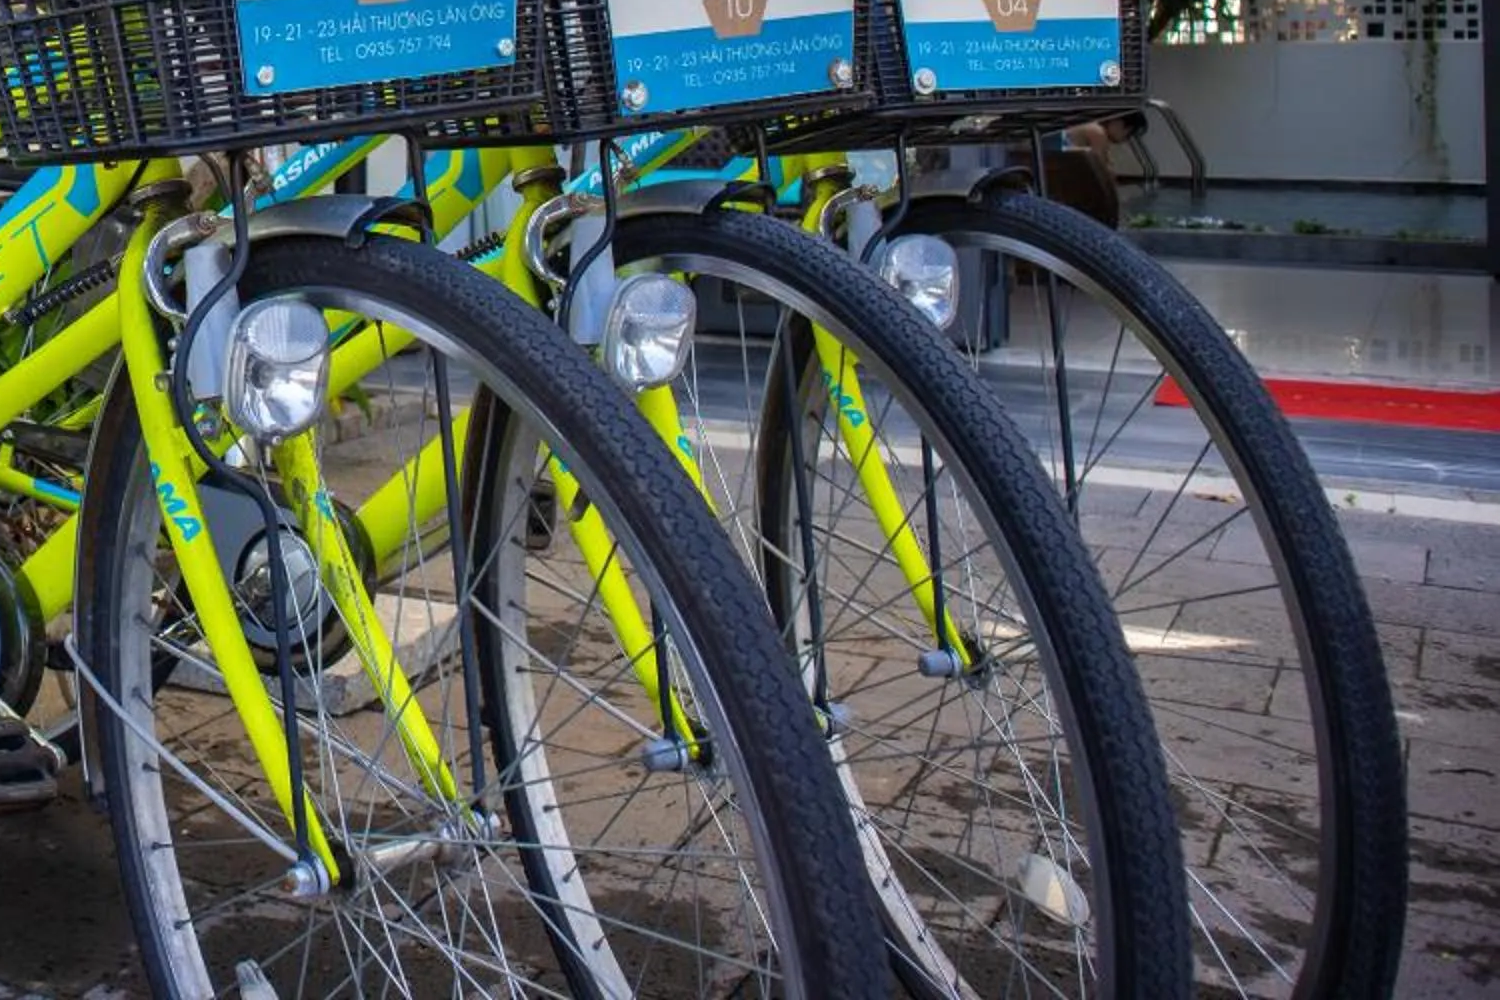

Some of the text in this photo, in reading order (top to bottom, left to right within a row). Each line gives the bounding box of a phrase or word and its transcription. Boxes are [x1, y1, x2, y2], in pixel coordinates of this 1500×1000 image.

[254, 26, 273, 45] 19
[285, 23, 302, 42] 21
[317, 19, 337, 39] 23
[355, 41, 395, 60] 0935
[626, 56, 643, 73] 19
